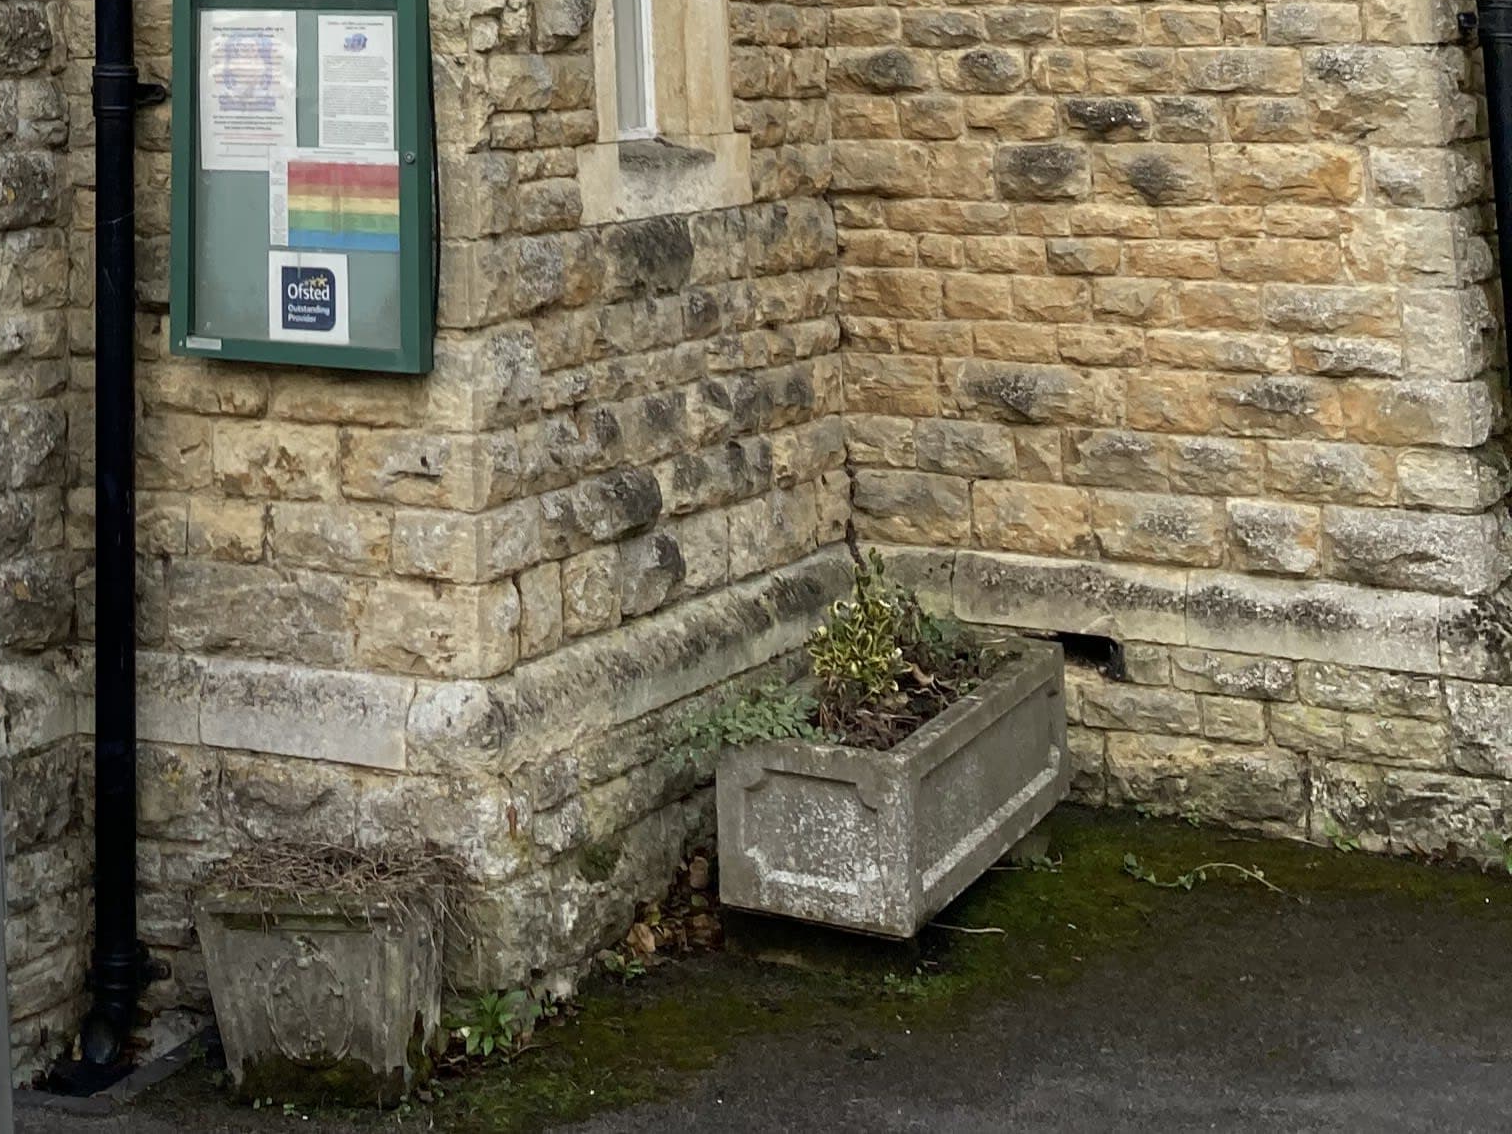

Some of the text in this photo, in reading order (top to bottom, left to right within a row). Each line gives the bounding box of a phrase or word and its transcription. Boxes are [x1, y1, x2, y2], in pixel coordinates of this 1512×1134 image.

[287, 282, 330, 301] Ofsted
[287, 304, 331, 316] Outstanding
[287, 313, 317, 323] Provider
